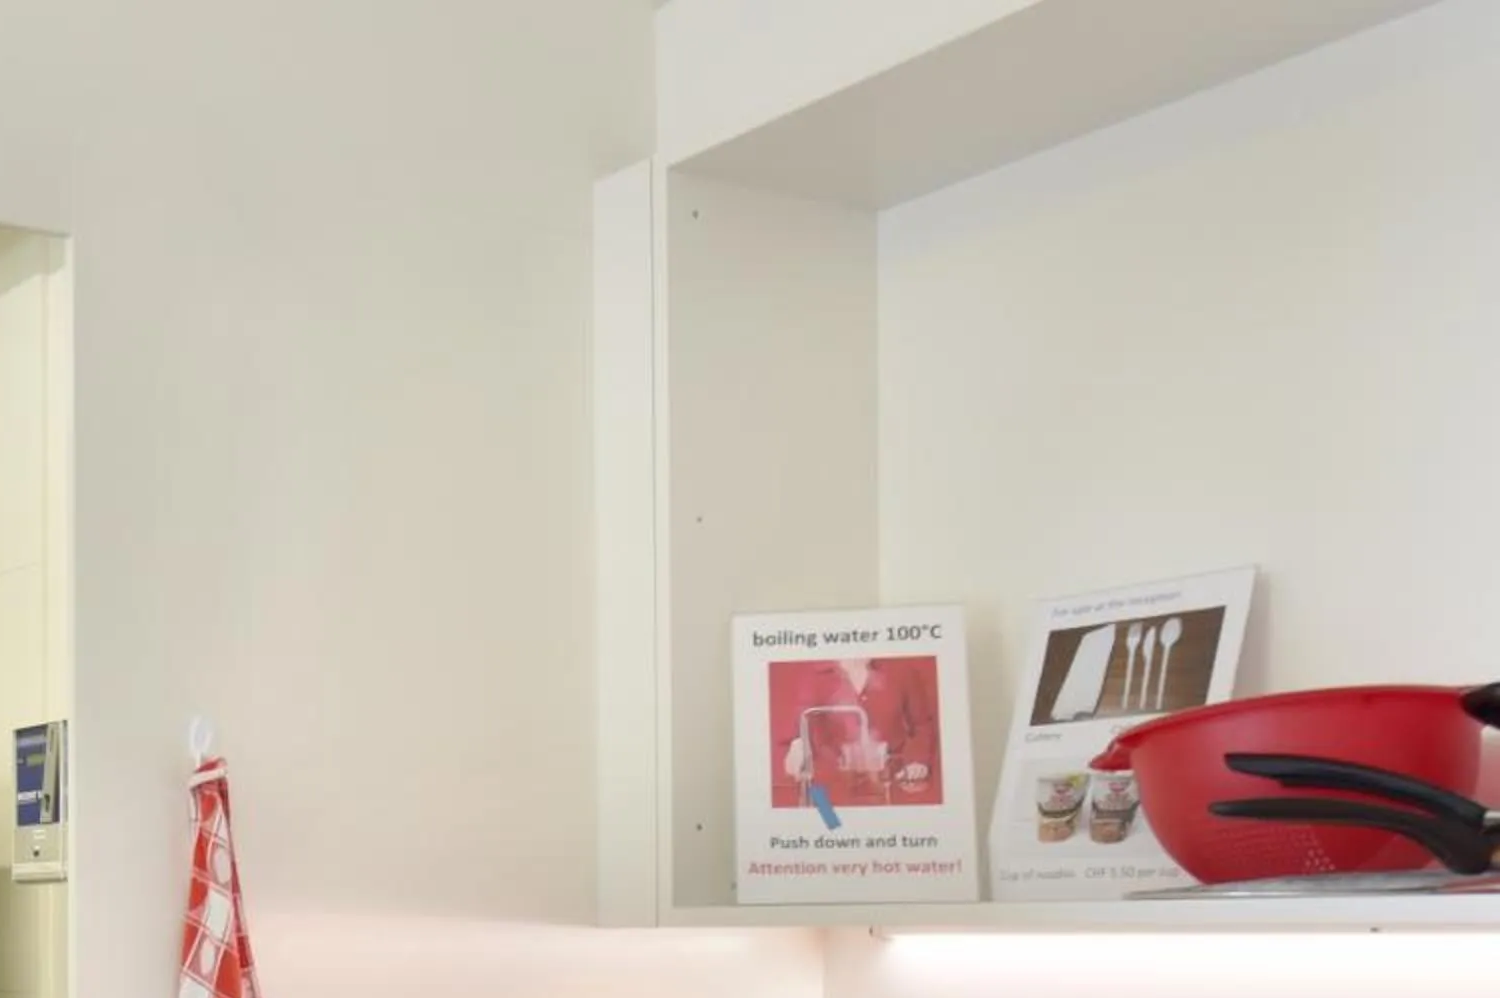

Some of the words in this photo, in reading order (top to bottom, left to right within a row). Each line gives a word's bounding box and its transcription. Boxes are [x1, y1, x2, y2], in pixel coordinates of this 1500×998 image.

[753, 629, 818, 648] boiling
[823, 629, 878, 645] water
[886, 624, 942, 641] 100°C
[770, 836, 809, 849] Push
[814, 836, 861, 848] down
[866, 835, 897, 848] and
[902, 835, 938, 848] turn
[749, 860, 827, 875] Attention
[832, 862, 868, 876] very
[872, 859, 900, 873] hot
[905, 858, 962, 873] water!
